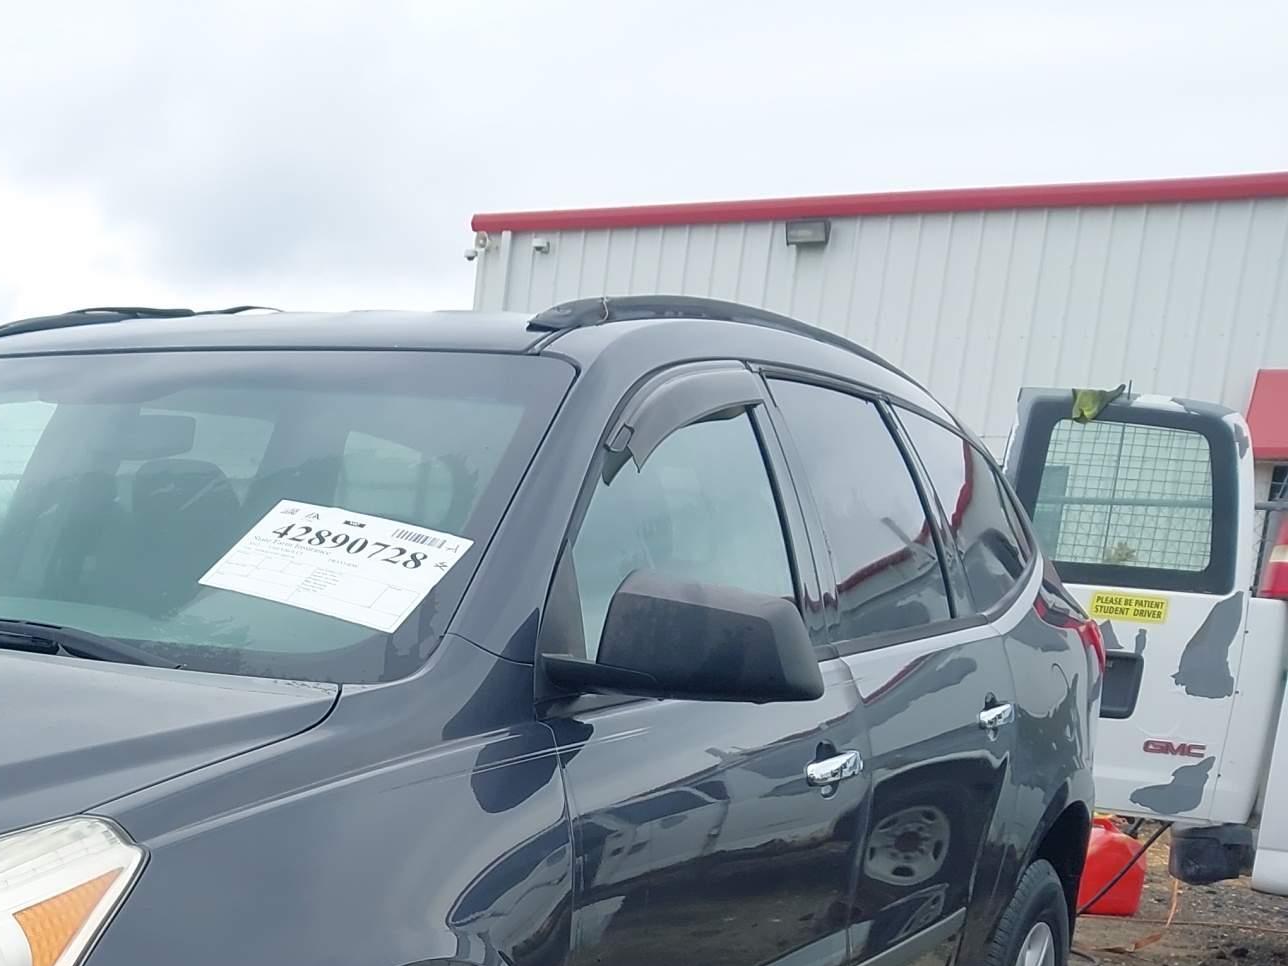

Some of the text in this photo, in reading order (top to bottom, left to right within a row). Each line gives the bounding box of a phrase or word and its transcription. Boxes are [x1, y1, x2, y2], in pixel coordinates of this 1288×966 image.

[272, 523, 428, 570] 42890728
[1096, 595, 1165, 609] PLEASE BE PATIENT
[1095, 605, 1162, 619] STUDENT DRIVER
[1143, 740, 1206, 758] GMC
